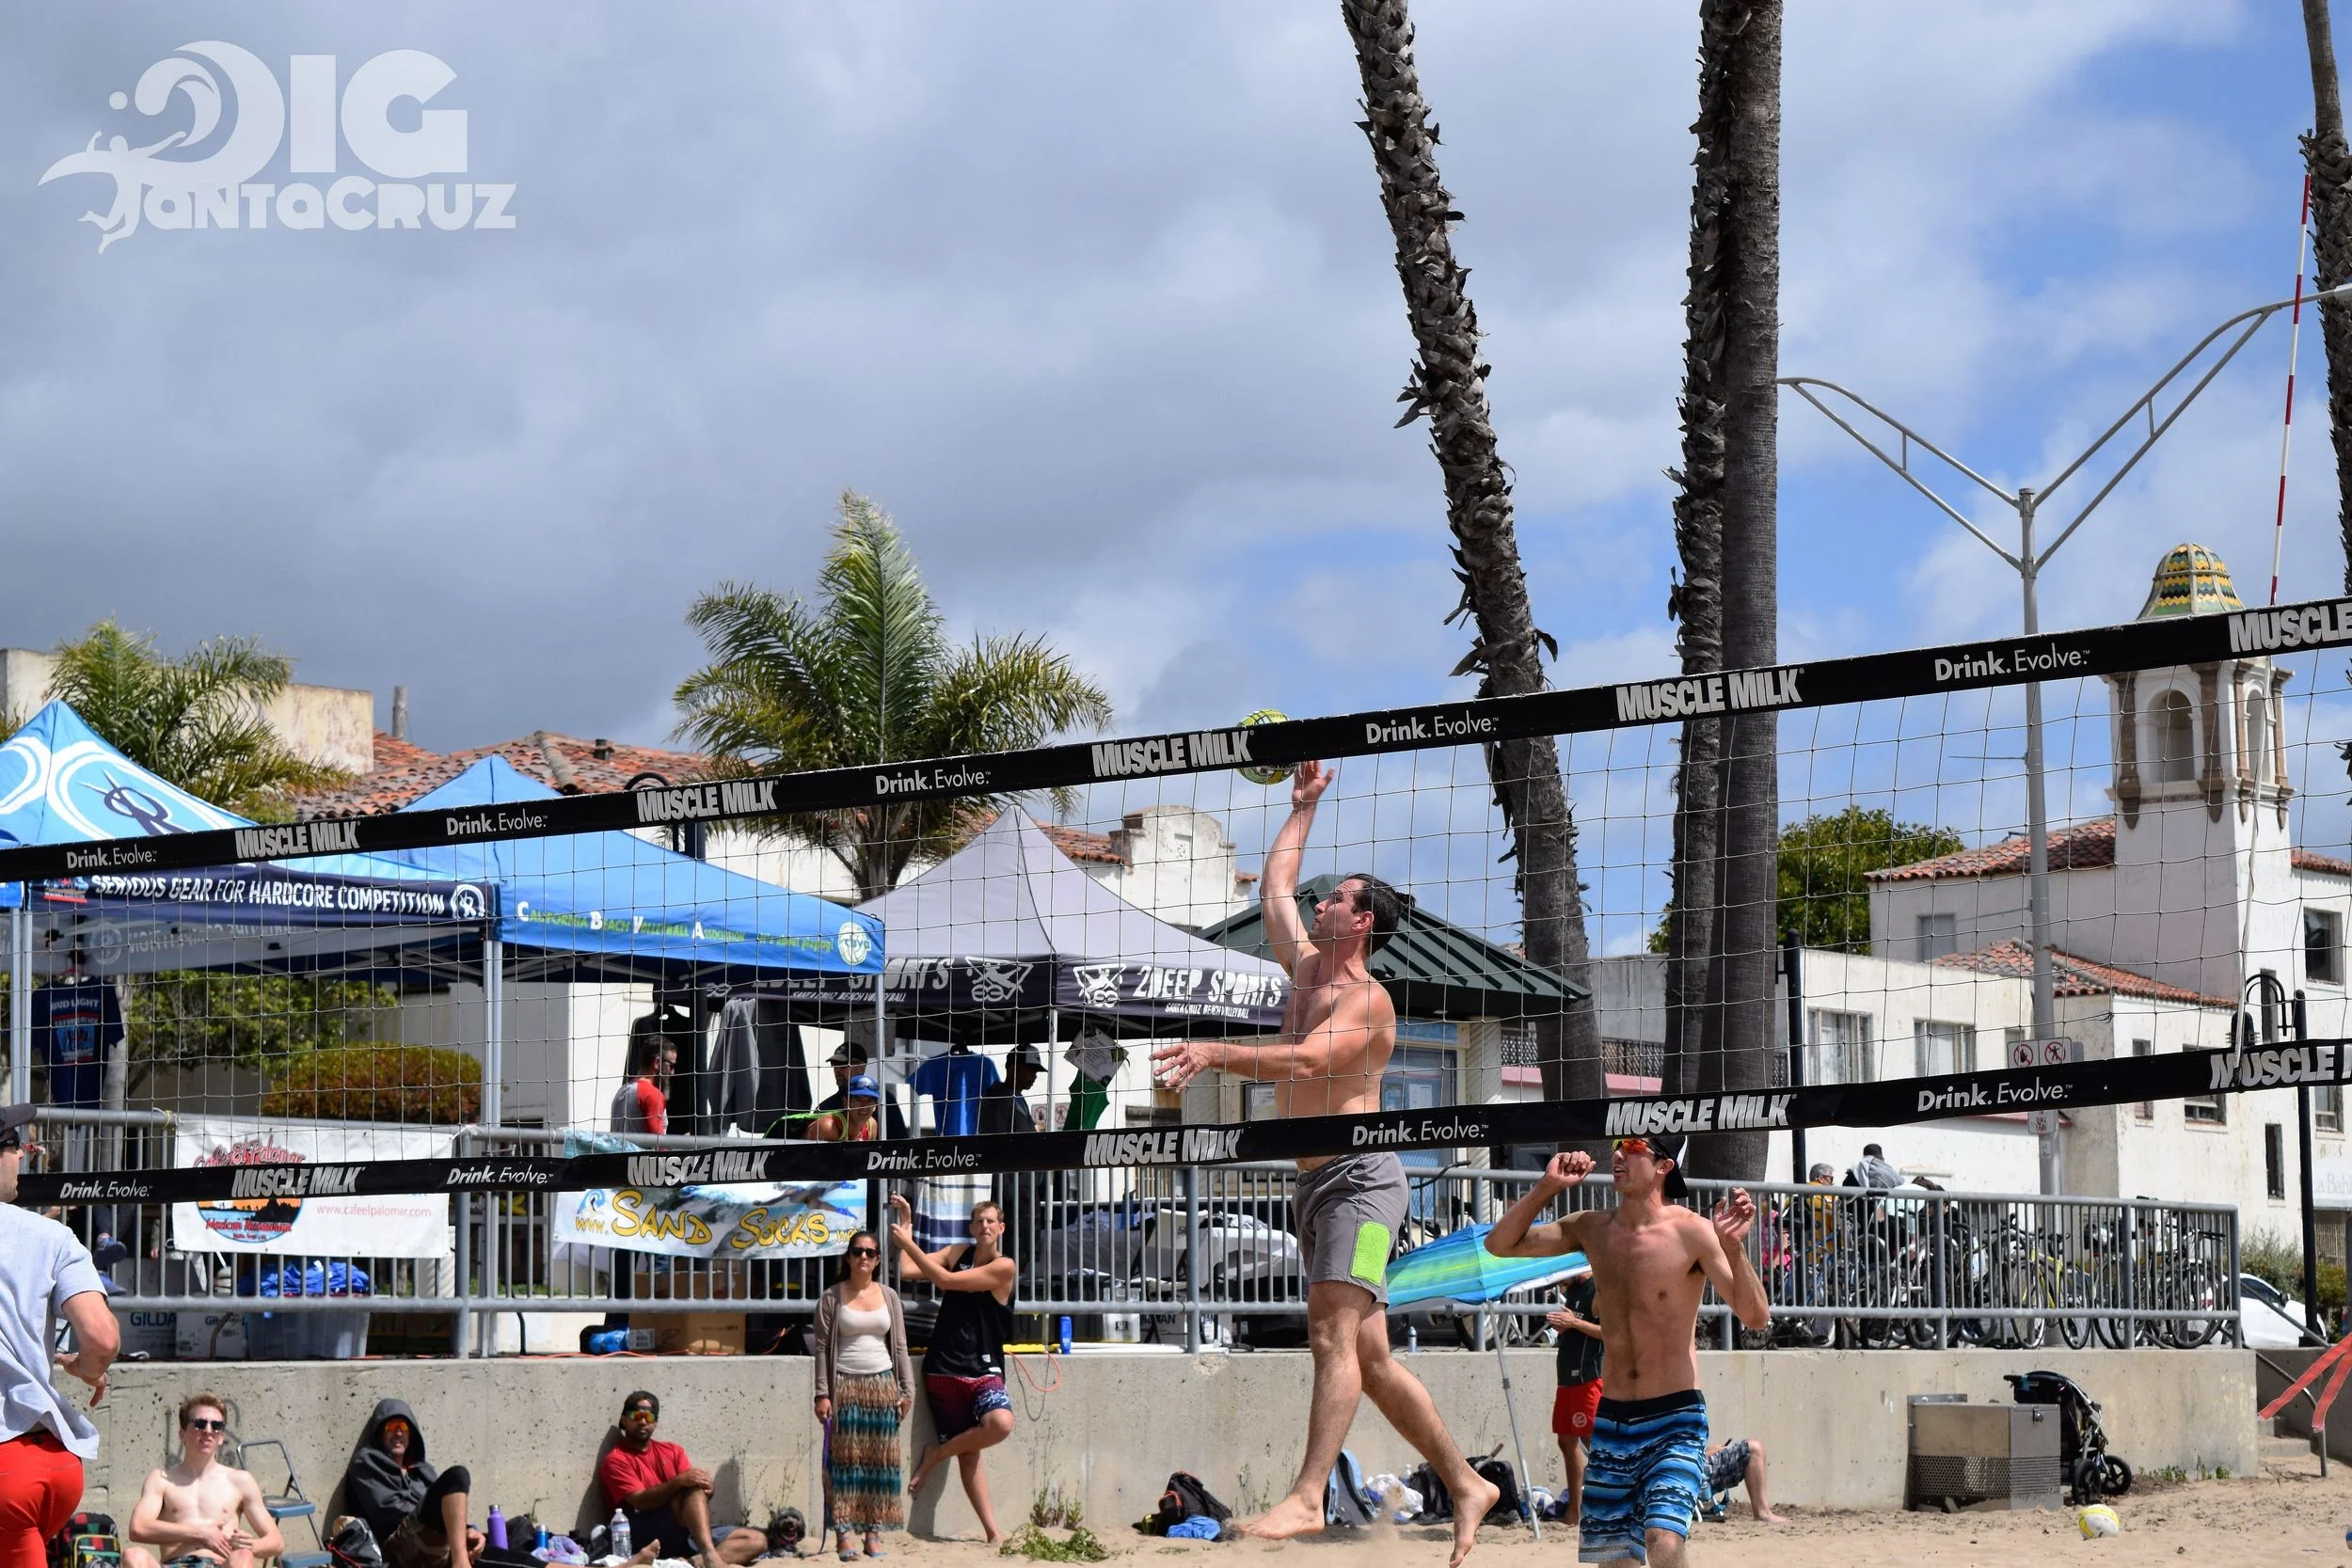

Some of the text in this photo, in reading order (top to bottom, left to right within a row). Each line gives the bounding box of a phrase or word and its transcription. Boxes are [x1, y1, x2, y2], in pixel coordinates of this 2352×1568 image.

[1935, 651, 2010, 681] Drink.
[1616, 675, 1725, 722] MUSCLE
[1366, 721, 1432, 743] Drink.
[1092, 737, 1186, 777] MUSCLE
[876, 773, 932, 795] Drink.
[637, 786, 720, 822] MUSCLE
[447, 814, 496, 835] Drink.
[67, 847, 111, 868] Drink.
[235, 829, 309, 858] MUSCLE
[91, 875, 445, 916] SERIOUS GEAR FOR HARDCORE COMPETITION
[1133, 965, 1282, 1007] 2DEEP SPORTS
[1918, 1084, 1992, 1112] Drink.
[1605, 1099, 1714, 1135] MUSCLE
[1353, 1121, 1416, 1145] Drink.
[867, 1149, 922, 1170] Drink.
[1084, 1132, 1178, 1165] MUSCLE
[231, 1168, 310, 1197] MUSCLE
[447, 1165, 495, 1184] Drink.
[628, 1154, 711, 1186] MUSCLE
[60, 1180, 103, 1198] Drink.
[317, 1204, 432, 1217] www.cafeelpalomar.com
